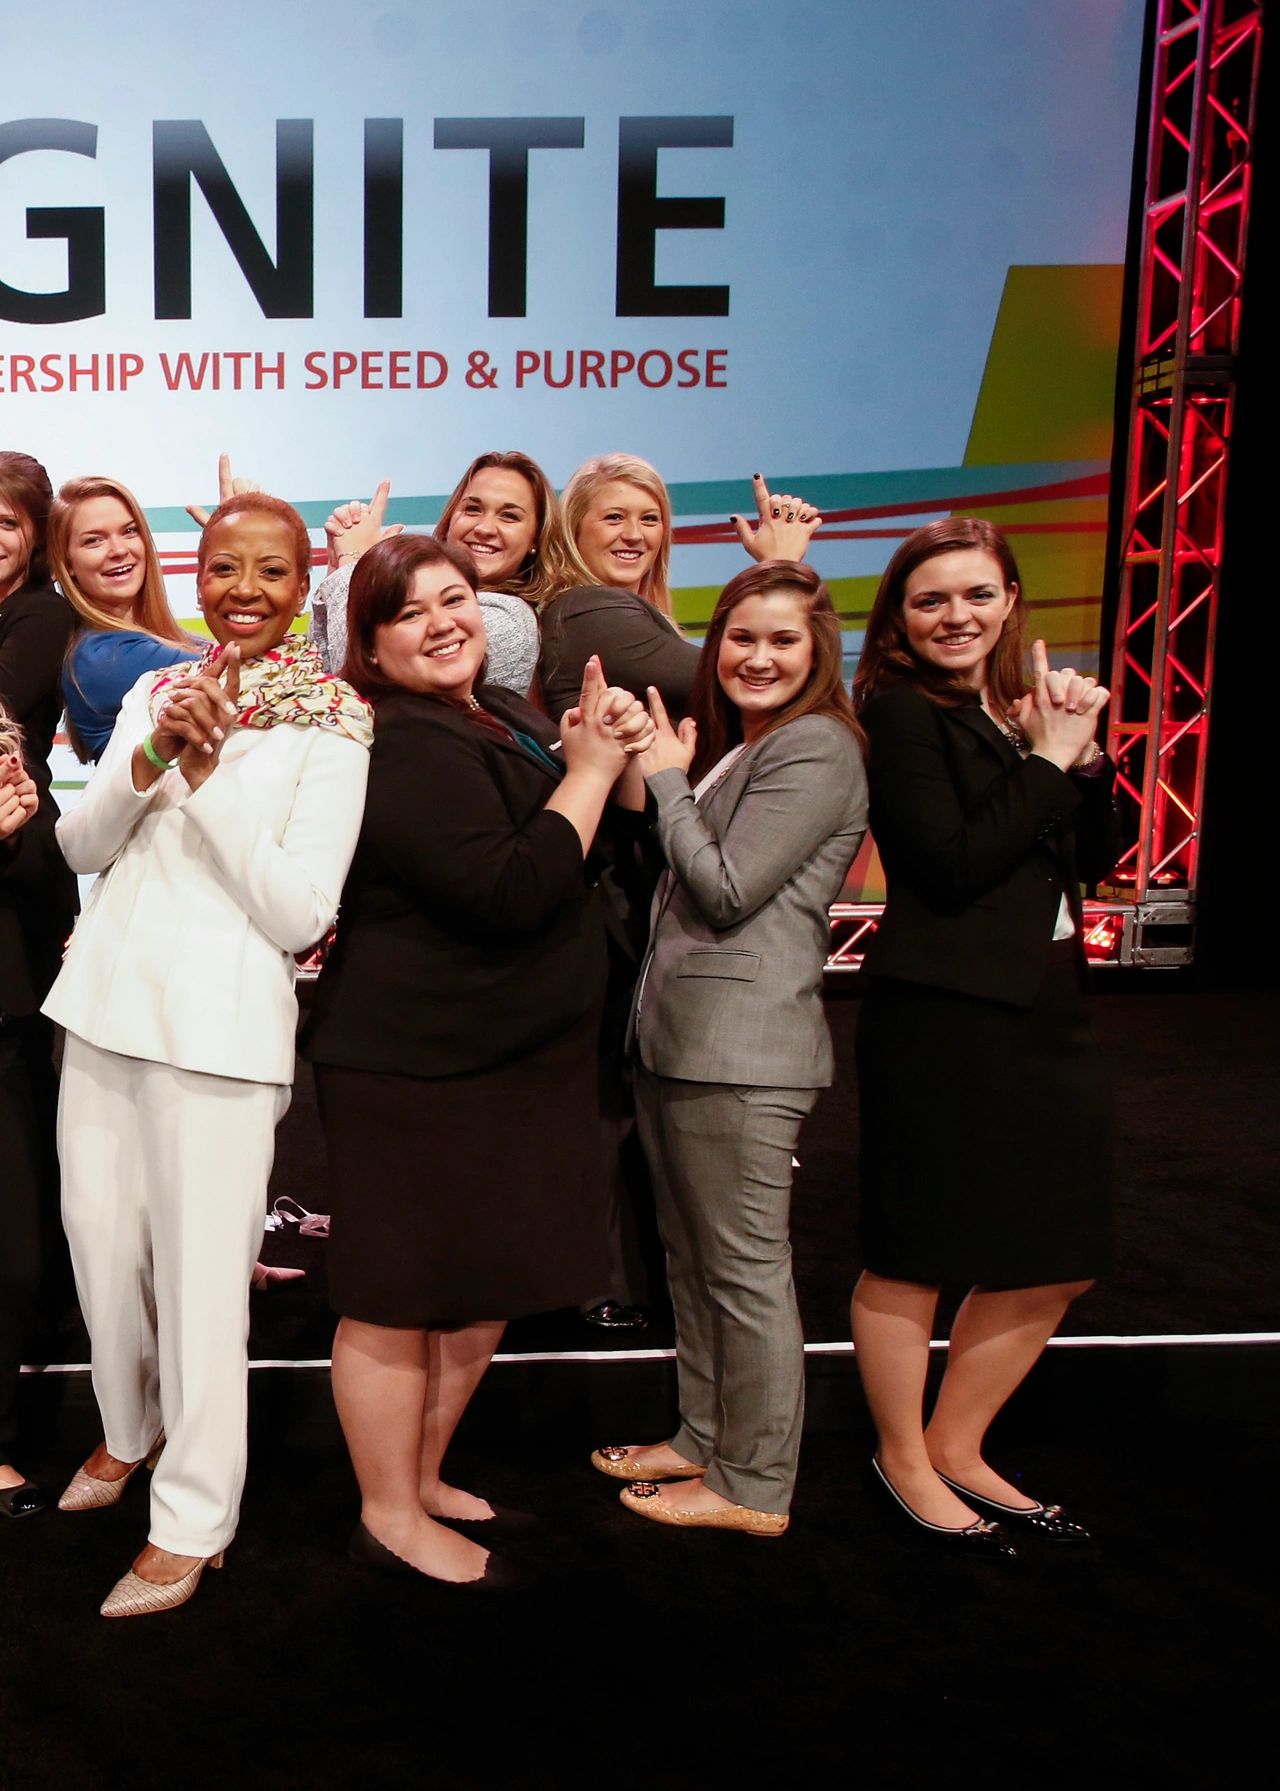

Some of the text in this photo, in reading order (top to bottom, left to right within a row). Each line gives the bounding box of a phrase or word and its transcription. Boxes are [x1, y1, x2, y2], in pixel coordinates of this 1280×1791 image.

[158, 351, 286, 391] WITH
[303, 350, 449, 390] SPEED
[464, 350, 498, 389] &
[515, 349, 729, 388] PURPOSE
